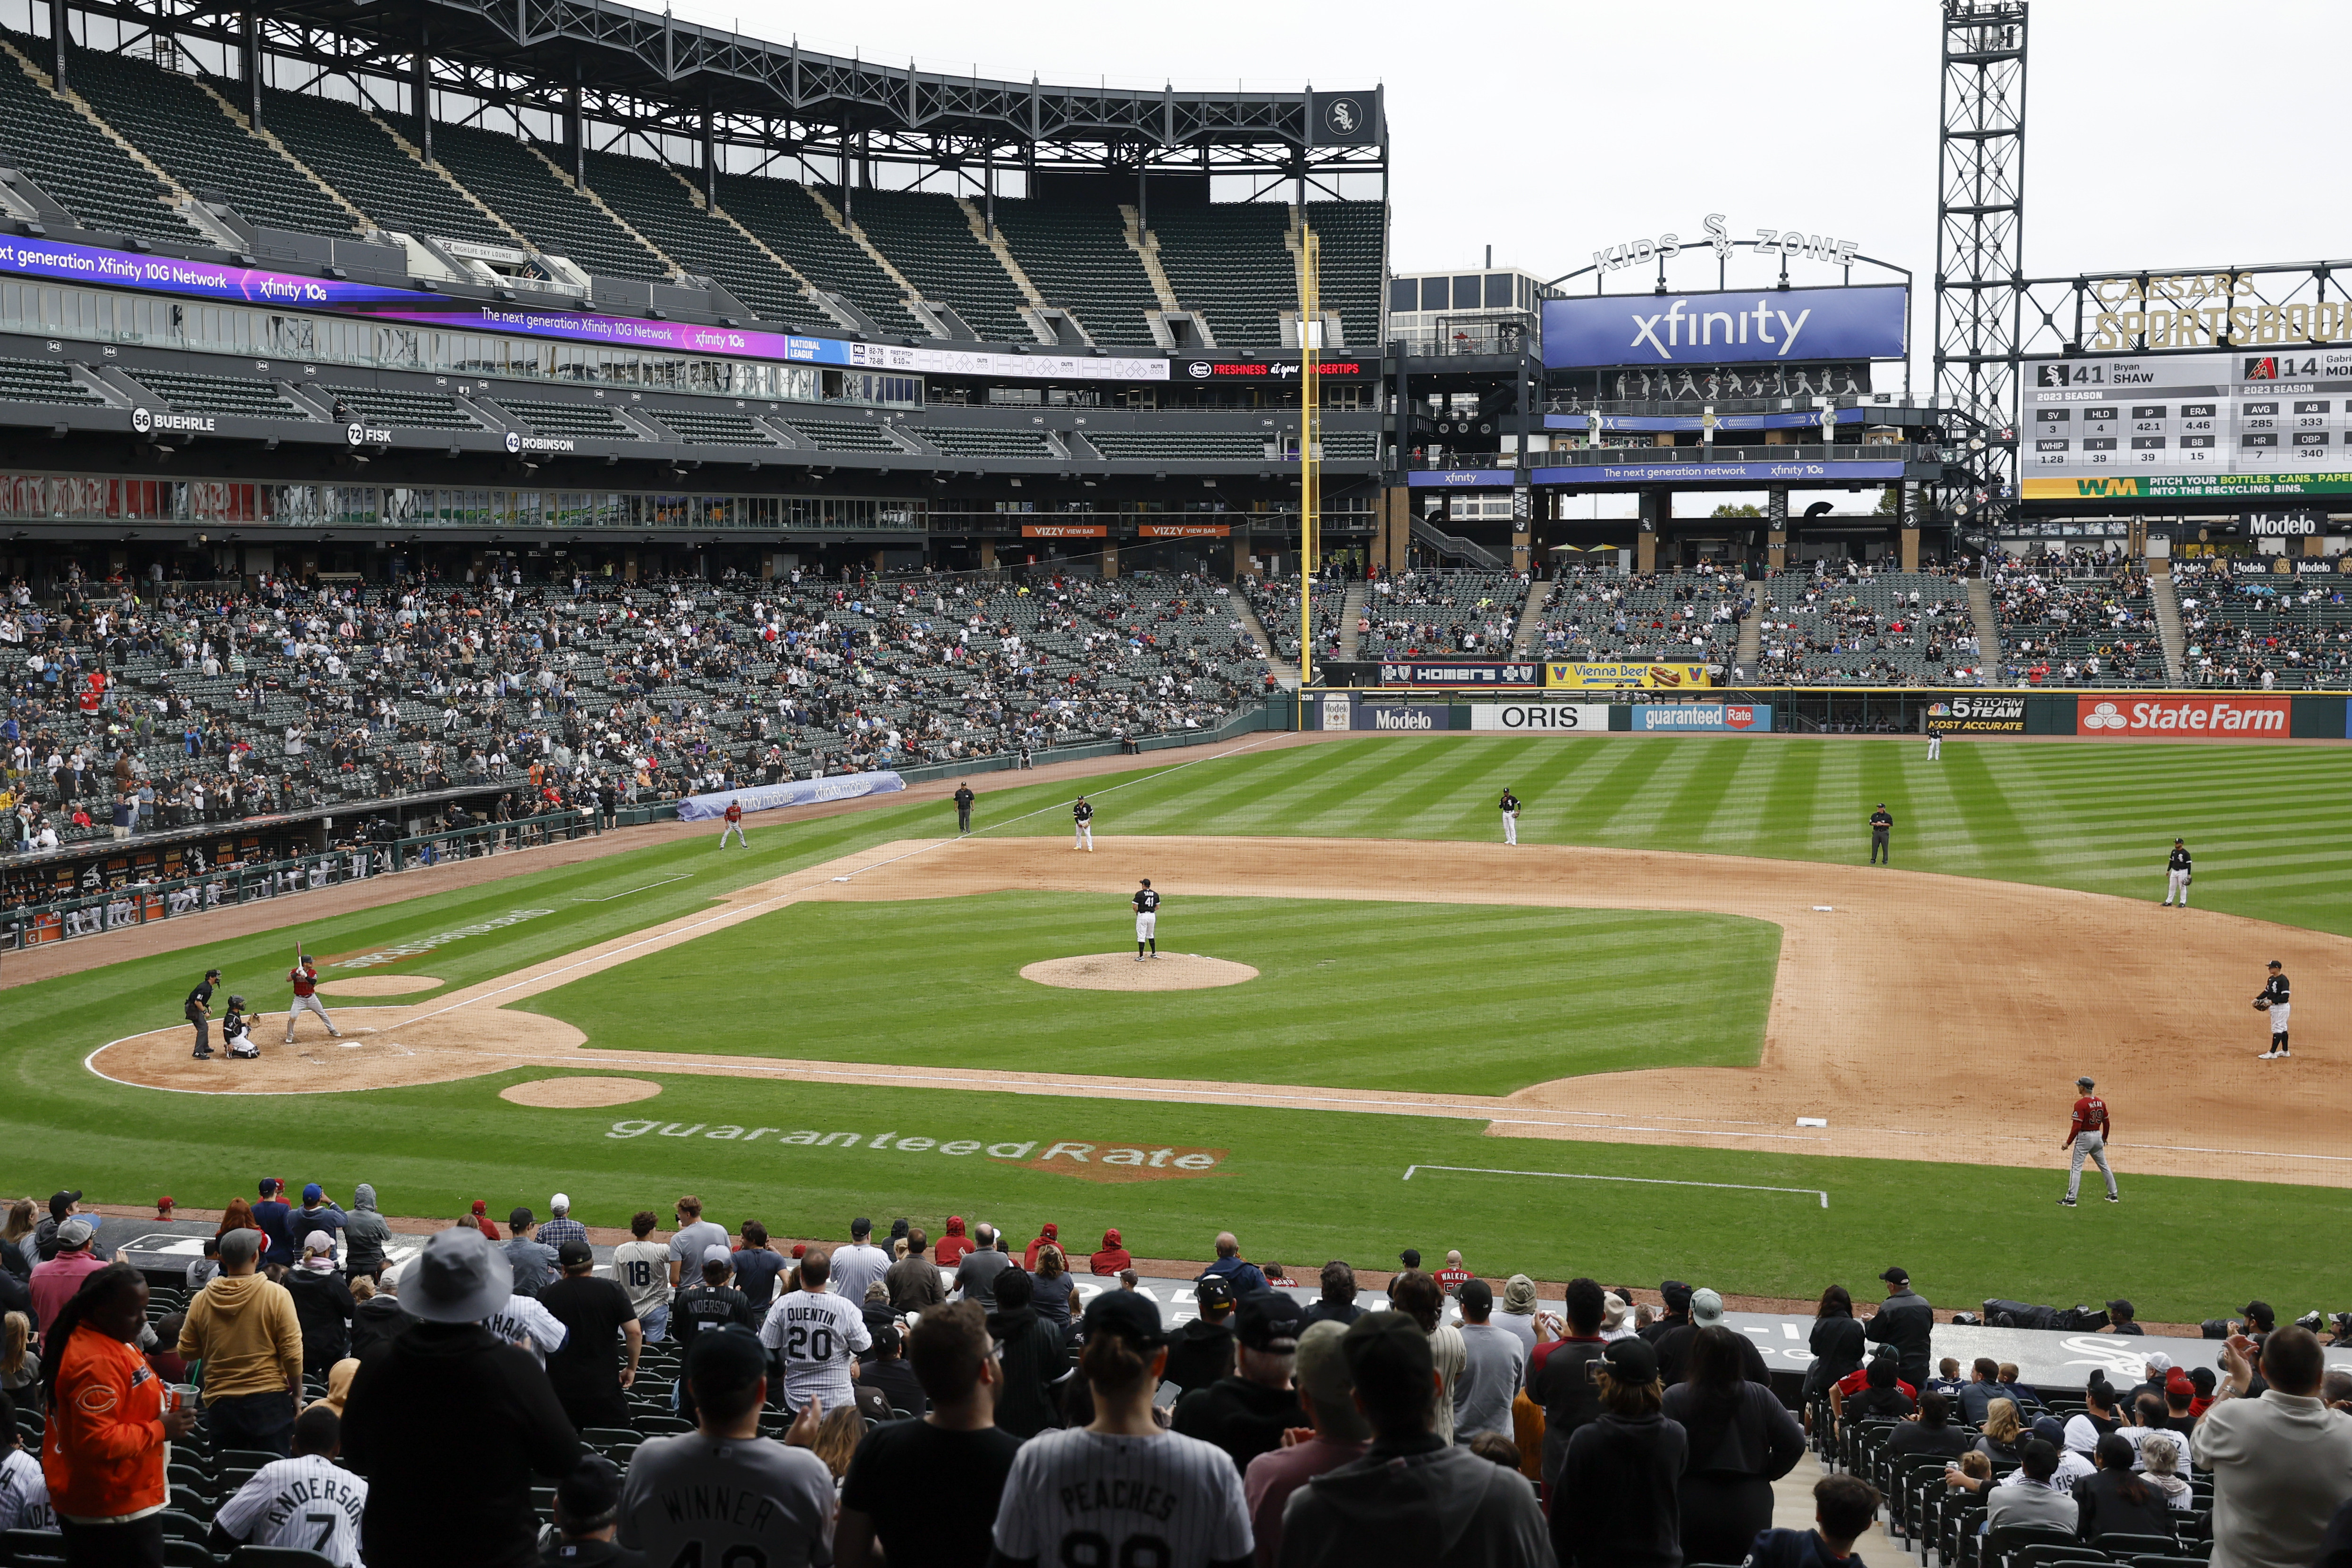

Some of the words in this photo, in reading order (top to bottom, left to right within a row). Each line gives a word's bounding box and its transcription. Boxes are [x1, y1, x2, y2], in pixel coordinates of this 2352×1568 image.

[1593, 233, 1680, 274] KIDS
[1754, 229, 1859, 267] ZONE
[18, 250, 94, 271] generation
[98, 256, 142, 282] Xfinity
[145, 263, 169, 281] 10G
[173, 267, 227, 288] Network
[260, 278, 302, 301] xfinity
[305, 284, 327, 301] 10G
[2097, 273, 2254, 302] CAESARS
[482, 306, 500, 321] The
[503, 312, 524, 325] next
[527, 316, 579, 330] generation
[581, 319, 613, 337] Xfinity
[615, 323, 631, 335] 10G
[634, 325, 672, 341] Network
[1630, 299, 1811, 359] xfinity
[695, 330, 726, 349] xfinity
[729, 335, 744, 348] 10G
[790, 338, 821, 351] NATIONAL
[790, 348, 813, 359] LEAGUE
[855, 345, 864, 354] MIA
[854, 355, 865, 364] NYM
[1214, 364, 1267, 375] FRESHNESS
[1270, 363, 1281, 374] at
[1281, 365, 1300, 378] your
[1309, 364, 1359, 374] INGERTIPS
[2114, 364, 2140, 372] Bryan
[2284, 358, 2318, 377] 14
[2073, 366, 2104, 384] 41
[2114, 373, 2153, 383] SHAW
[2065, 392, 2102, 400] SEASON
[2243, 386, 2270, 394] 2023
[2274, 384, 2313, 393] SEASON
[135, 414, 149, 426] 56
[153, 415, 215, 431] BUEHRLE
[2186, 421, 2210, 429] 4.46
[2301, 418, 2322, 426] 333
[350, 429, 361, 439] 72
[366, 429, 391, 442] FISK
[508, 437, 518, 447] 42
[522, 437, 573, 451] ROBINSON
[2093, 454, 2107, 462] 39
[1604, 469, 1621, 478] The
[1623, 469, 1644, 477] next
[1647, 467, 1701, 480] generation
[1704, 466, 1746, 475] network
[1771, 465, 1804, 476] xfinity
[1806, 465, 1823, 474] 10G
[1445, 472, 1477, 484] xfinity
[2150, 477, 2183, 486] PITCH
[2186, 476, 2217, 485] YOUR
[2220, 475, 2275, 484] BOTTLES.
[2278, 474, 2314, 483] CANS.
[2318, 473, 2352, 482] PAPE
[2077, 478, 2138, 495] WM
[2150, 486, 2177, 495] INTO
[2180, 486, 2201, 495] THE
[2204, 485, 2269, 494] RECYCLING
[2274, 484, 2305, 493] BINS.
[1034, 527, 1065, 536] VIZZY
[2250, 514, 2315, 535] Modelo
[2297, 562, 2330, 572] Modelo
[1574, 665, 1616, 676] Vienna
[1621, 665, 1647, 676] Beef
[1325, 704, 1348, 713] Modelo
[1952, 697, 1970, 718] 5
[1973, 698, 2024, 707] STORM
[1971, 707, 2022, 718] TEAM
[1376, 710, 1431, 729] Modelo
[1502, 707, 1578, 727] ORIS
[1646, 706, 1722, 729] guaranteed
[1728, 710, 1751, 721] Rate
[1962, 721, 2023, 730] ACCURATE
[815, 785, 841, 800] xfinity
[217, 853, 235, 864] BUONA
[83, 879, 101, 887] SOX
[146, 885, 159, 893] RUSH
[85, 897, 99, 905] RUSH
[29, 934, 36, 943] G
[2089, 1109, 2103, 1124] 39
[610, 1119, 1037, 1159] guaranteed
[1041, 1143, 1215, 1171] Rate
[627, 1261, 650, 1286] 18
[1441, 1272, 1468, 1282] WALKER
[688, 1299, 732, 1316] ANDERSON
[788, 1307, 836, 1326] QUENTIN
[789, 1326, 832, 1361] 20
[76, 1385, 118, 1412] C
[268, 1477, 362, 1527] ANDERSON
[1059, 1479, 1177, 1520] PEACHES
[661, 1485, 774, 1532] WINNER
[305, 1513, 336, 1551] 7
